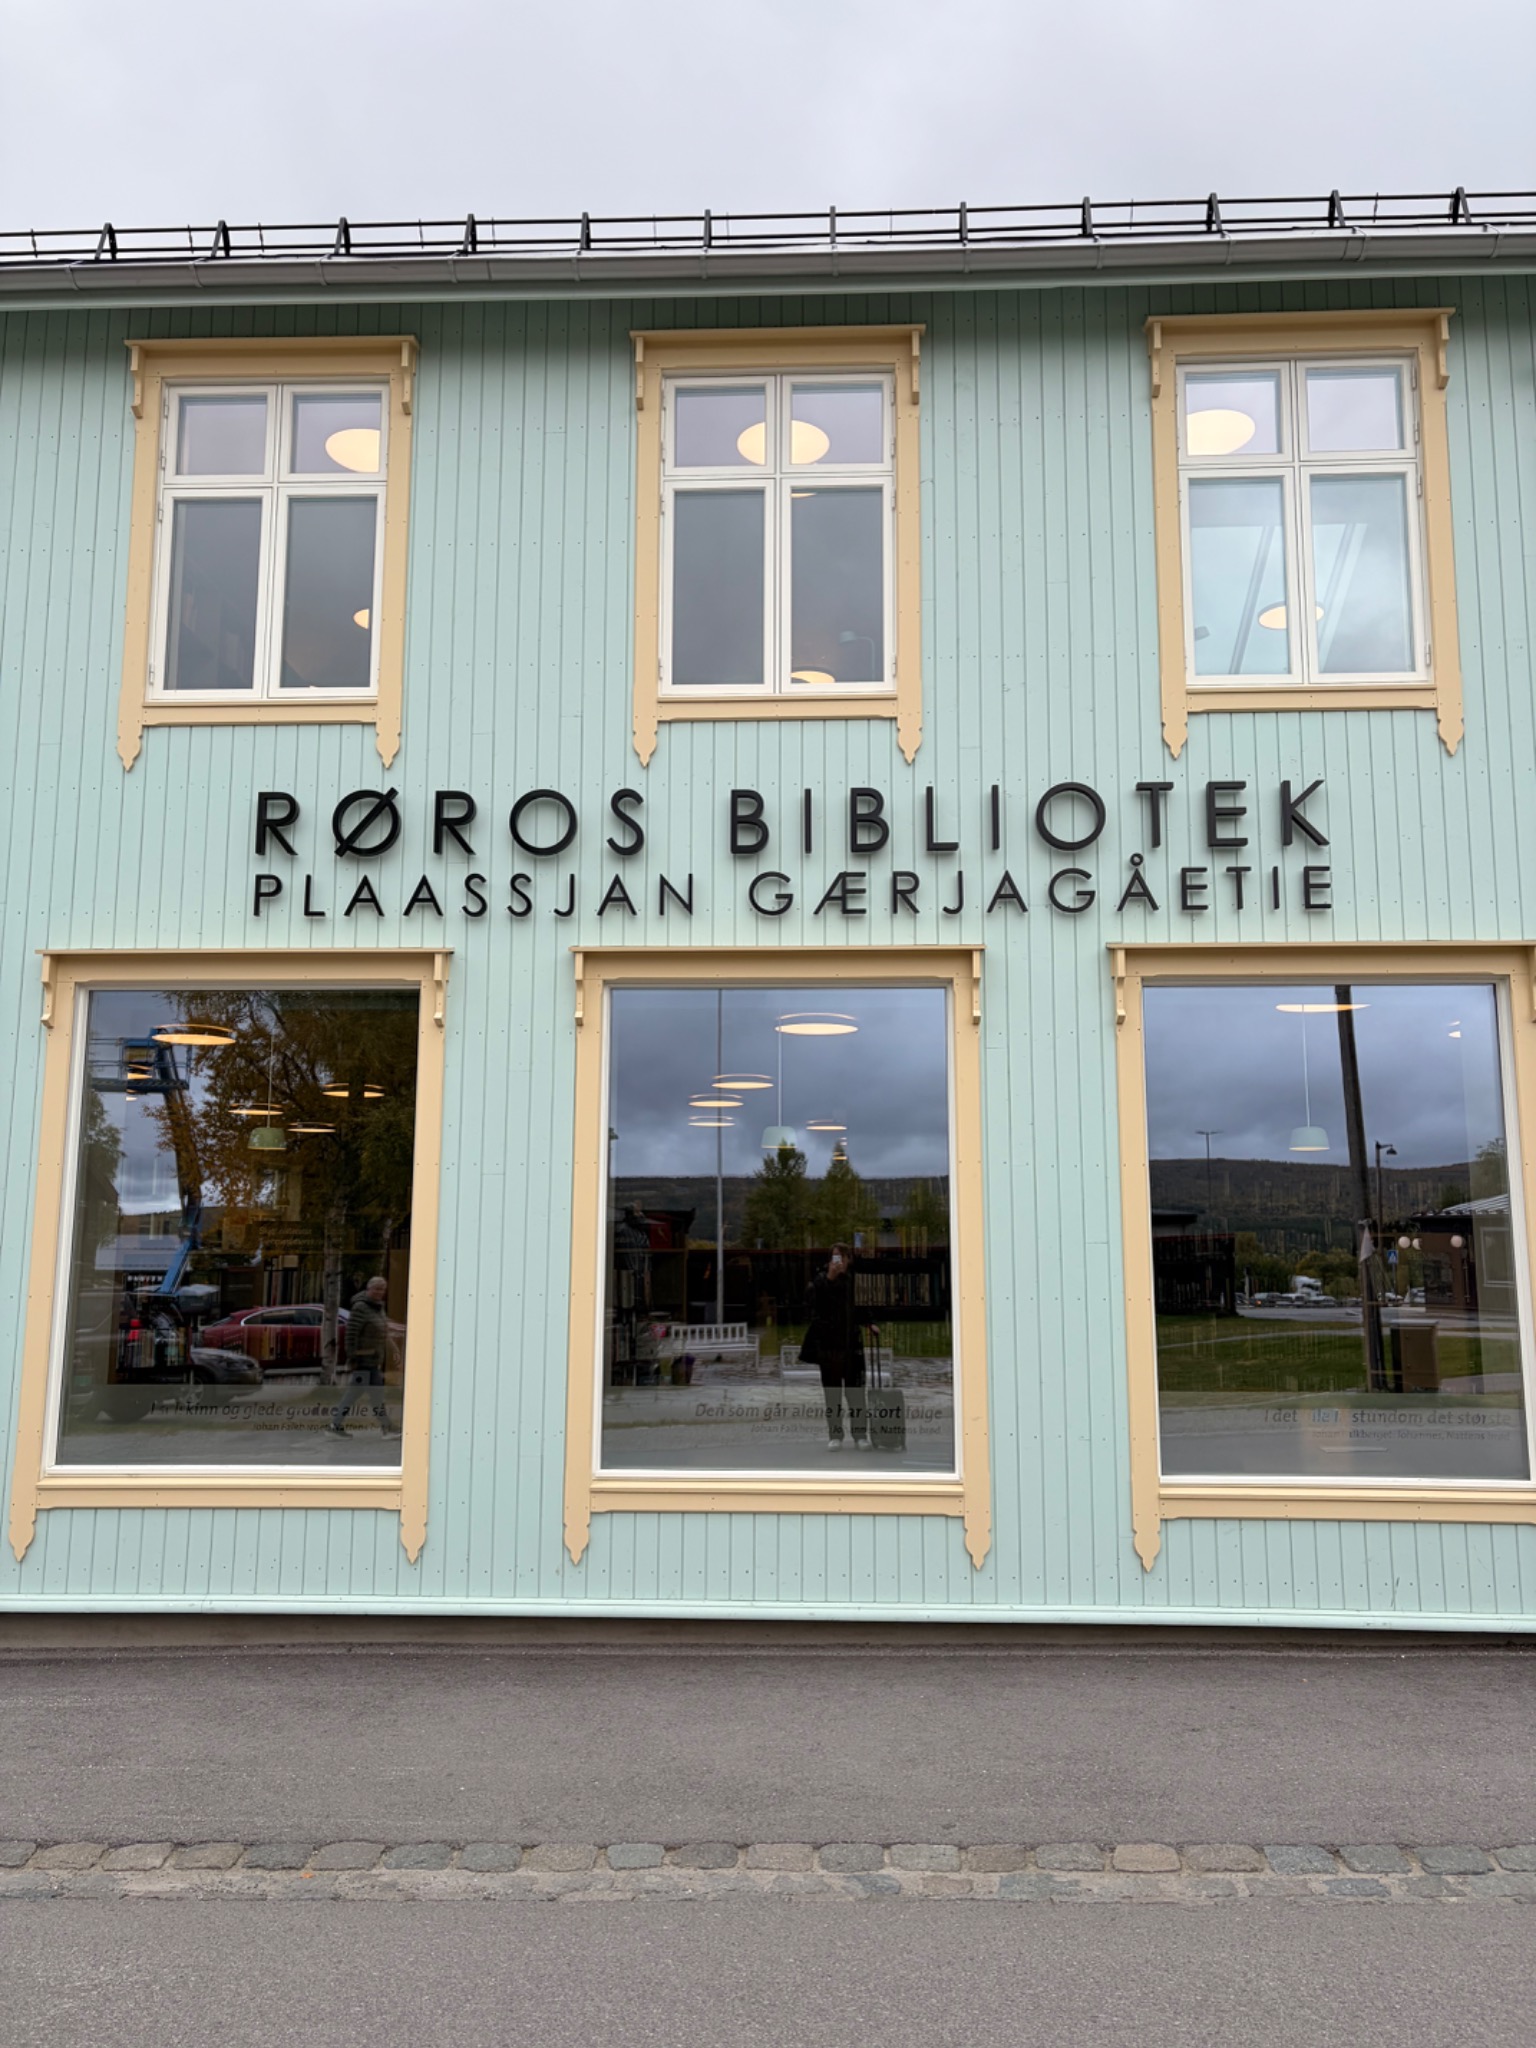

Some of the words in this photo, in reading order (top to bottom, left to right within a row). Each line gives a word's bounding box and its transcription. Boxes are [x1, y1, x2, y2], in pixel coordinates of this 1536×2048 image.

[254, 786, 645, 858] RØROS
[729, 779, 1331, 855] BIBLIOTEK
[253, 872, 694, 918] PLAASSJAN
[748, 852, 1333, 917] GÆRJAGÅETIE
[222, 1404, 241, 1420] og
[243, 1402, 282, 1420] glede
[342, 1402, 368, 1417] alle
[695, 1403, 727, 1417] Den
[729, 1405, 758, 1417] som
[763, 1402, 791, 1421] går
[792, 1403, 833, 1418] alene
[865, 1405, 902, 1419] stort
[905, 1404, 943, 1423] følge
[1272, 1408, 1298, 1423] det
[1351, 1409, 1423, 1424] stundom
[1427, 1409, 1454, 1424] det
[1457, 1411, 1511, 1425] største
